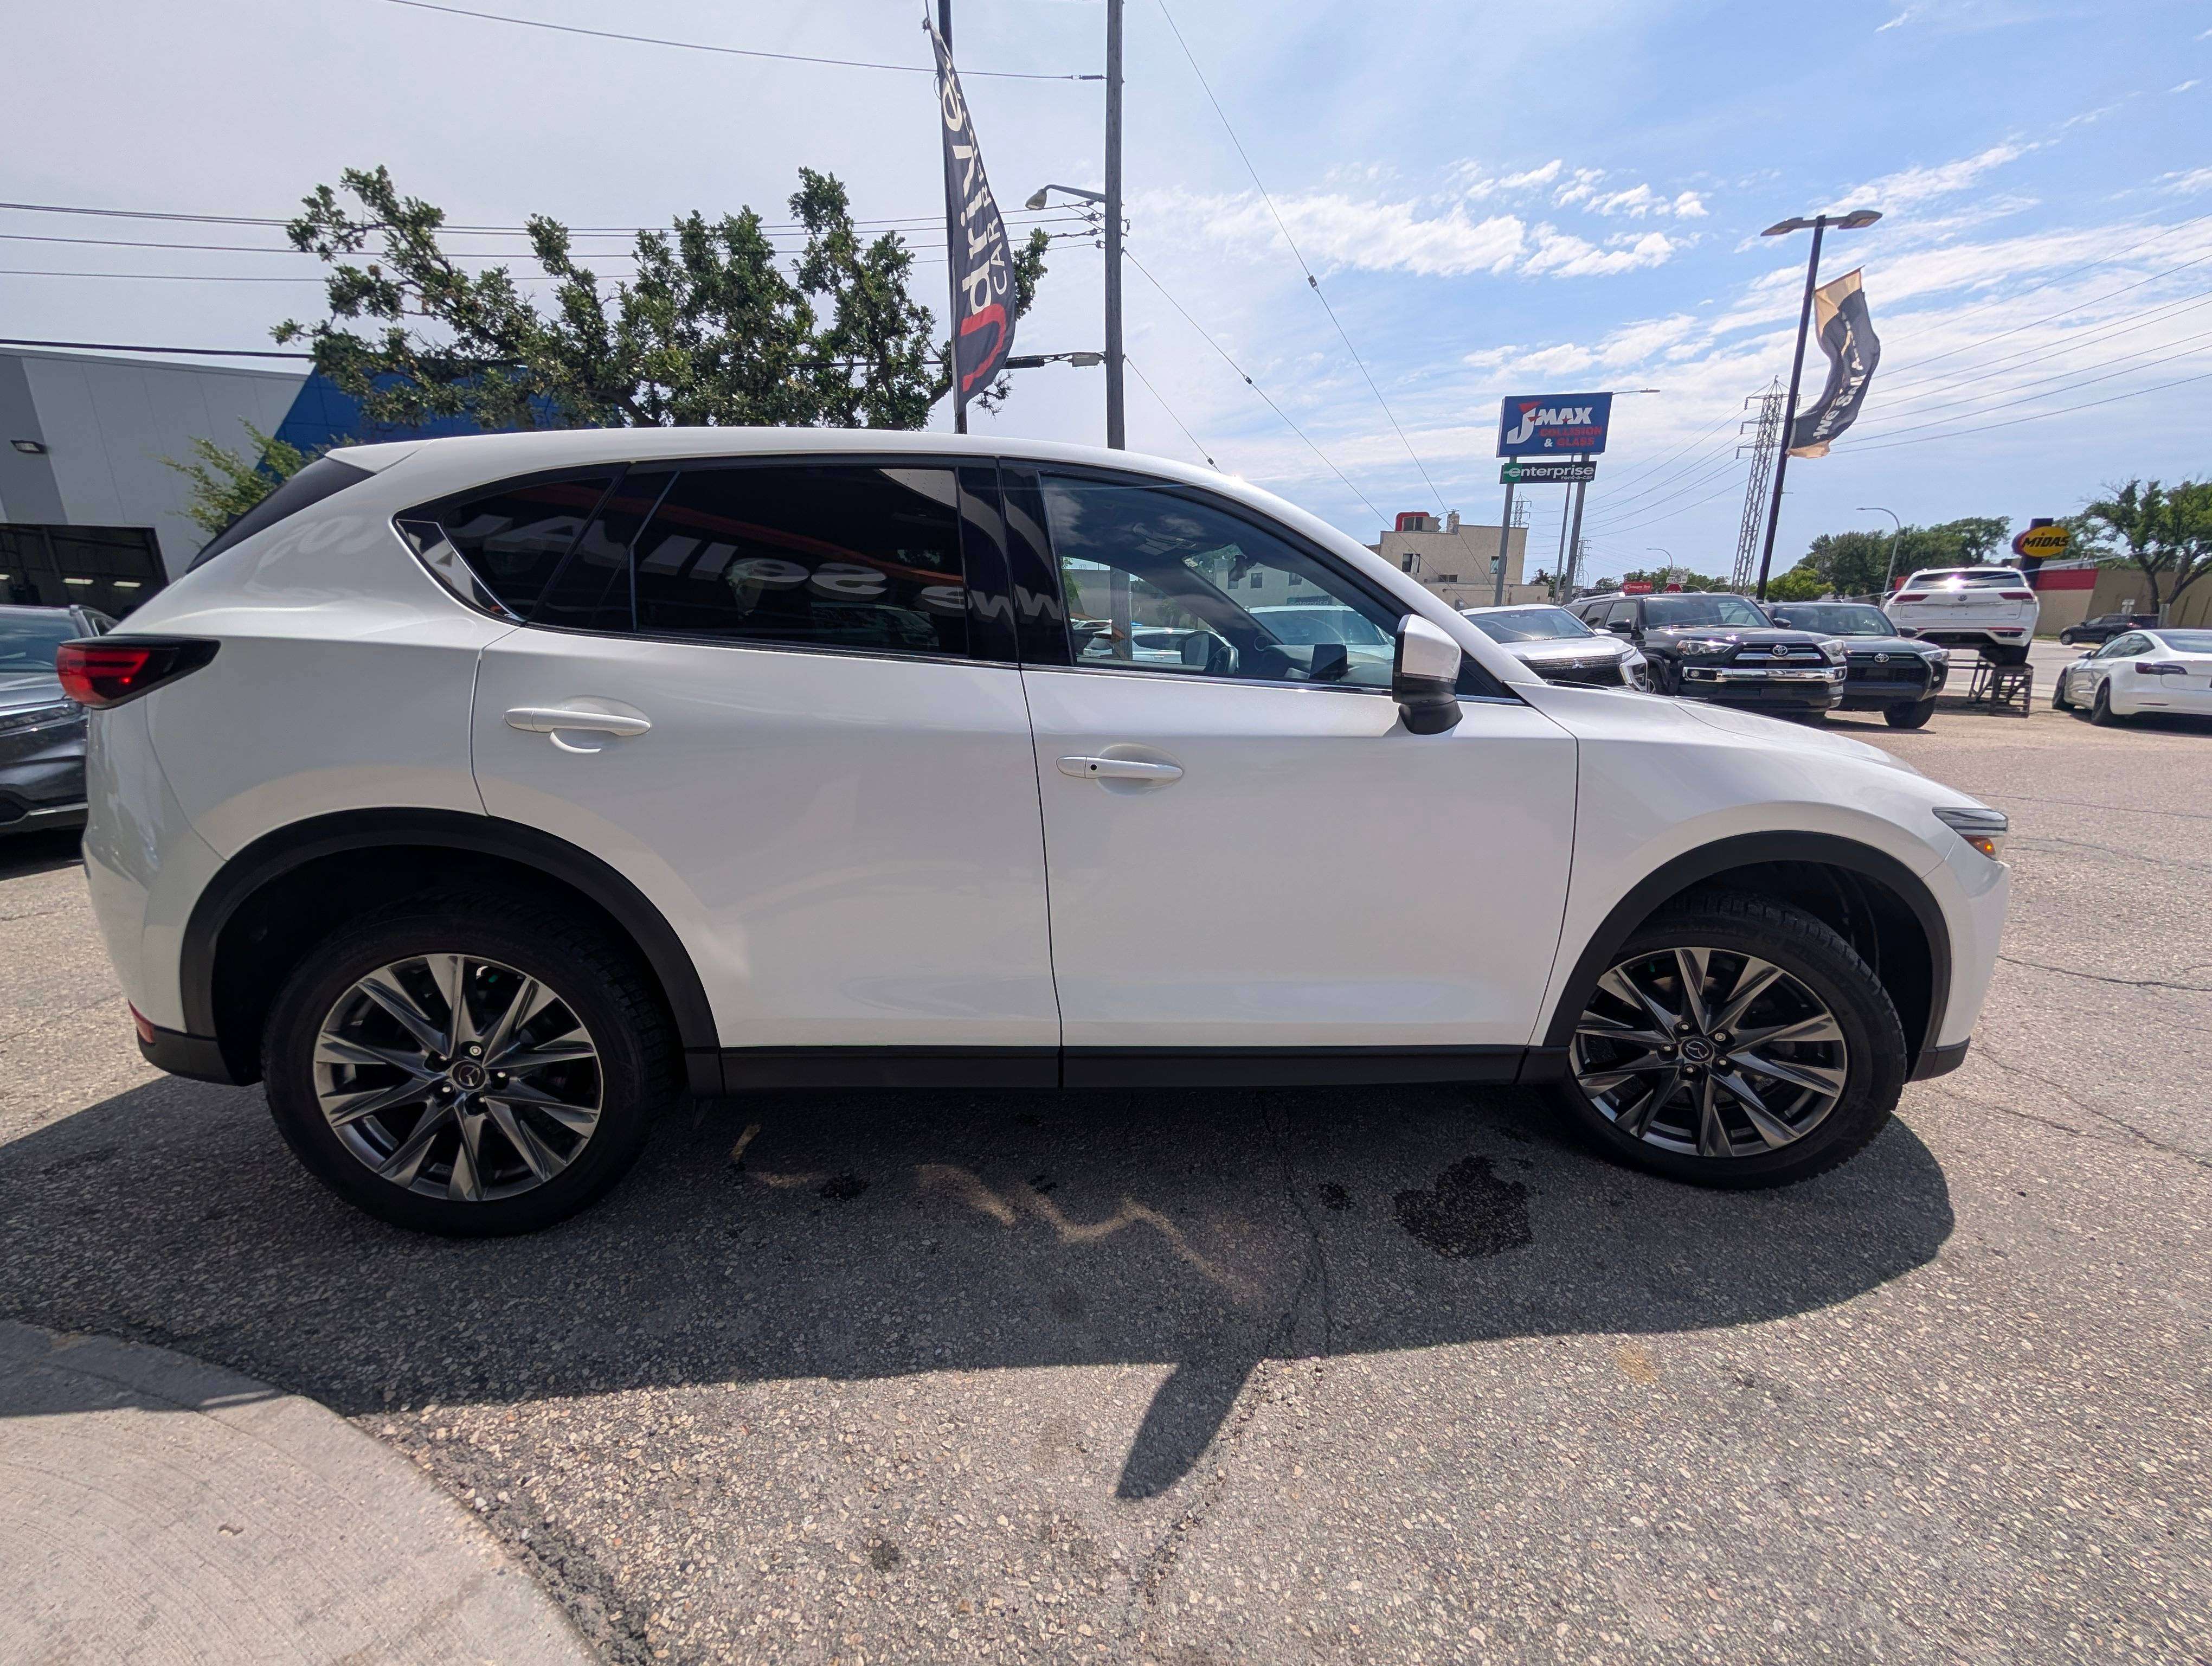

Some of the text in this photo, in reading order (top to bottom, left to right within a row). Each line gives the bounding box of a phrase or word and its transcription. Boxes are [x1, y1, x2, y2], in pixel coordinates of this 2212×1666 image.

[987, 216, 1007, 295] CAR
[1539, 426, 1603, 437] COLLISION
[1544, 437, 1596, 447] & GLASS
[1508, 464, 1594, 479] enterprise
[2022, 536, 2070, 547] MIDAS
